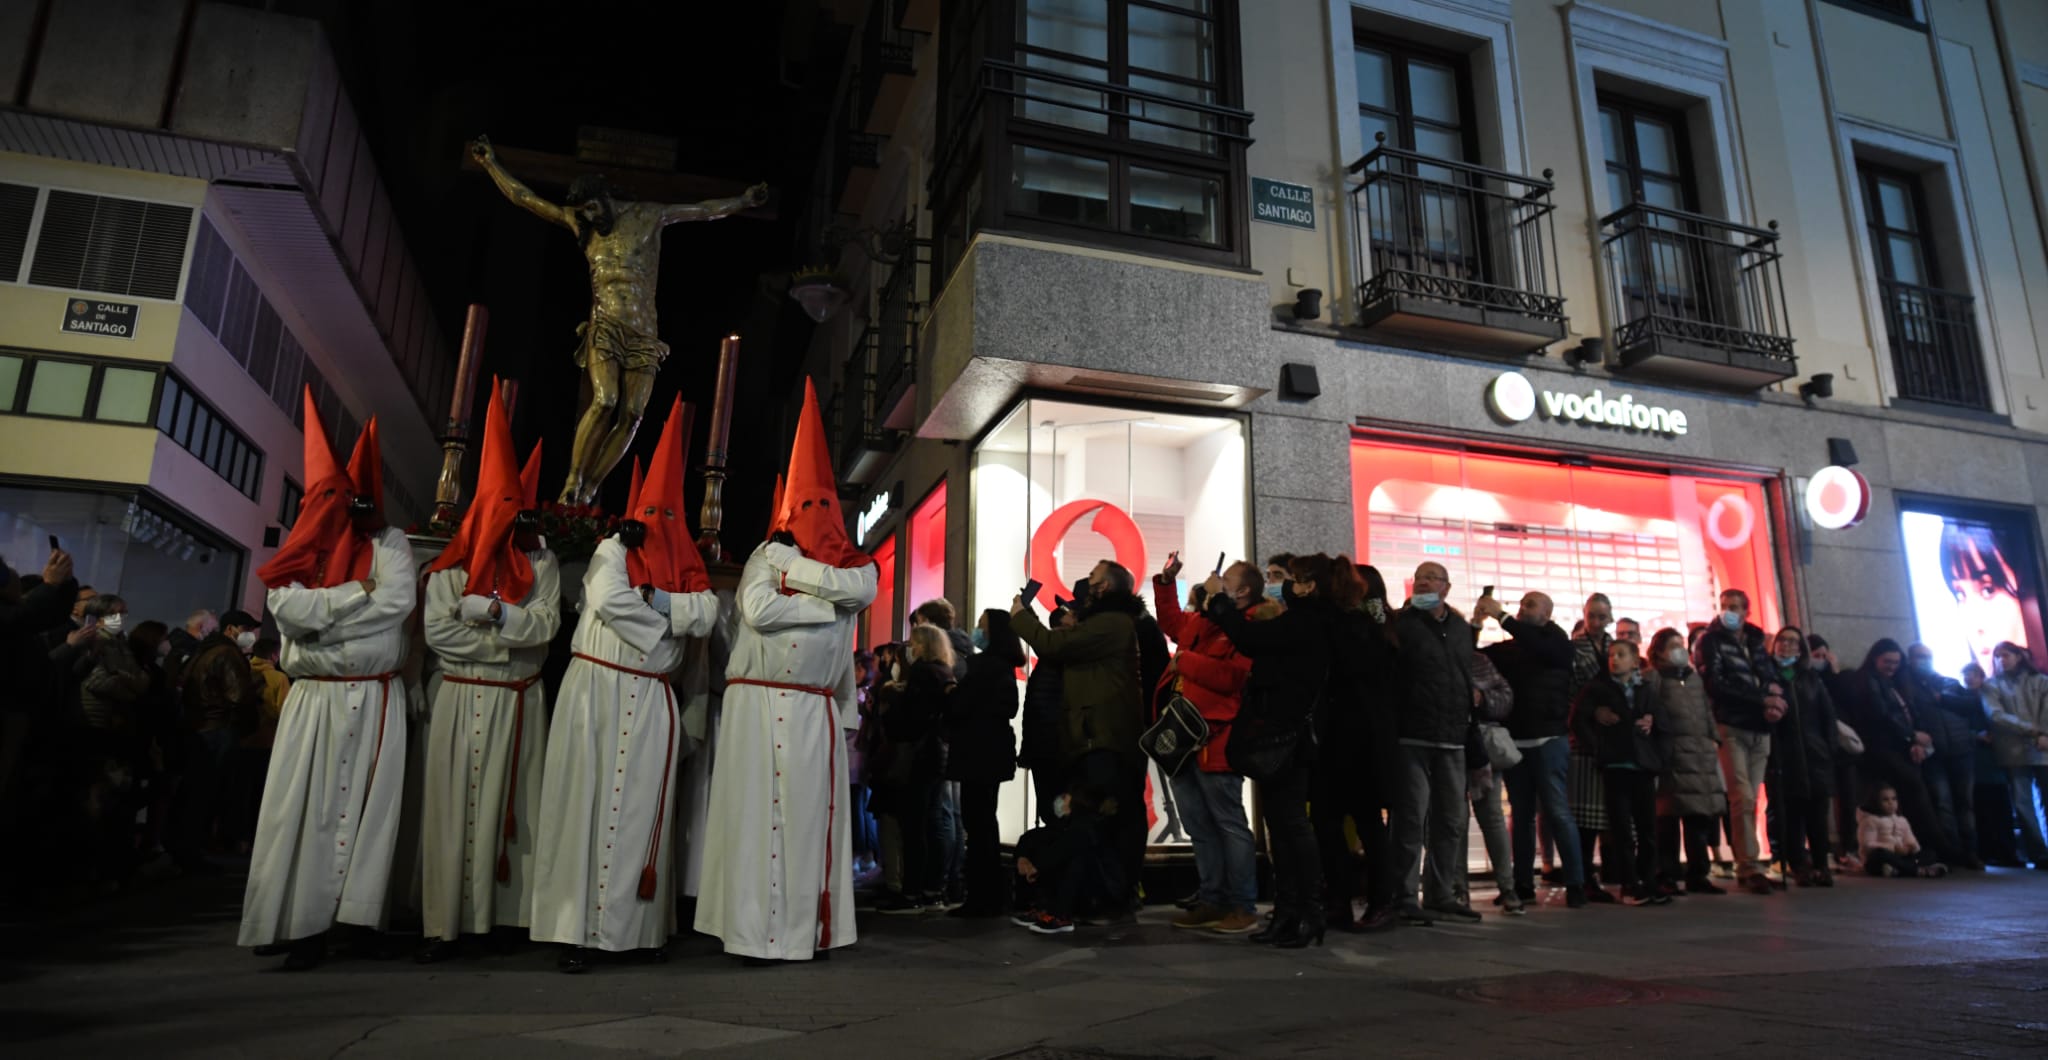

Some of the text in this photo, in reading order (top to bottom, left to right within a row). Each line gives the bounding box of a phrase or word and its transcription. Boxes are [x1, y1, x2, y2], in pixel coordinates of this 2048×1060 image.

[1270, 185, 1311, 203] CALLE
[1257, 202, 1312, 224] SANTIAGO
[97, 303, 129, 314] CALLE
[70, 320, 127, 335] SANTIAGO
[1543, 388, 1688, 435] vodafone
